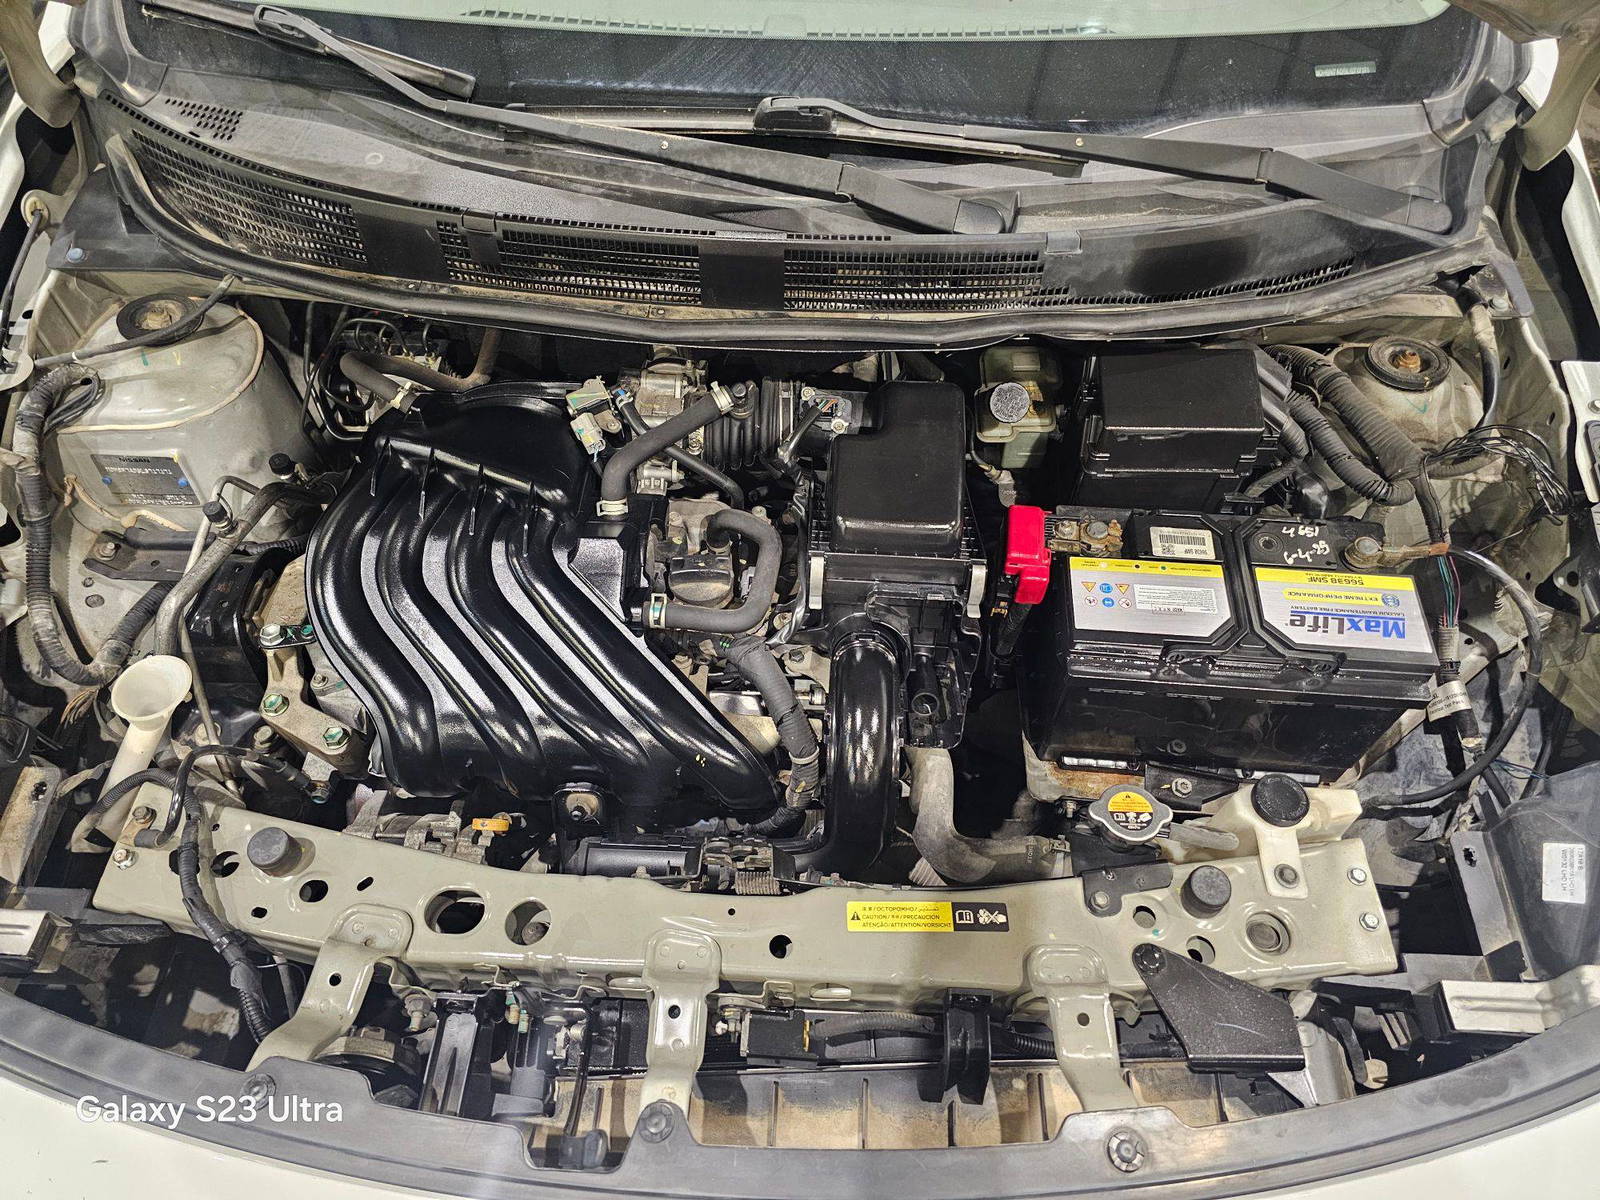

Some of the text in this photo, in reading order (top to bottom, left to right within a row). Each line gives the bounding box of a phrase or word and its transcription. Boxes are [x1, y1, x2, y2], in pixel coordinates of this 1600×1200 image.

[1307, 576, 1329, 584] SMF
[1287, 591, 1342, 600] PERFORMANCE
[1289, 614, 1405, 639] MaxLife
